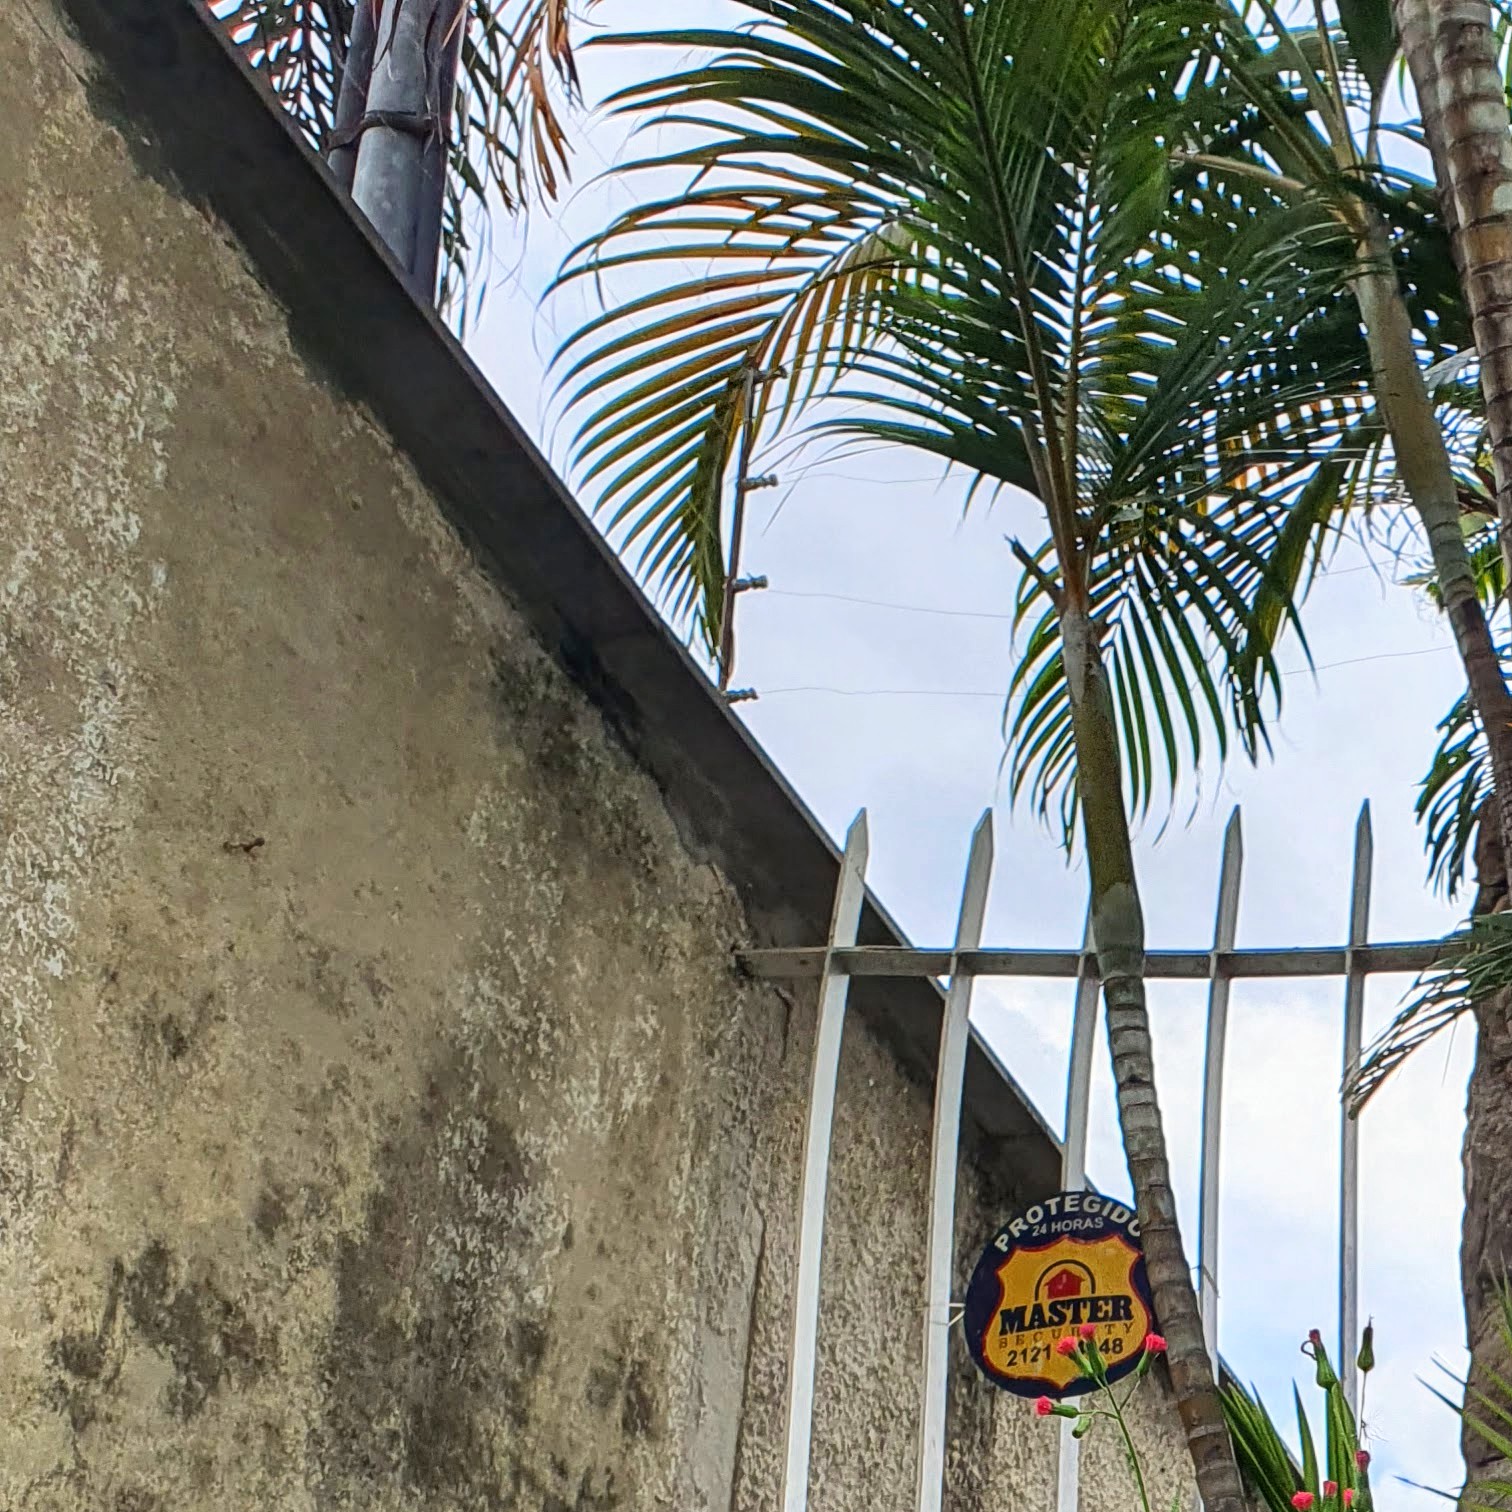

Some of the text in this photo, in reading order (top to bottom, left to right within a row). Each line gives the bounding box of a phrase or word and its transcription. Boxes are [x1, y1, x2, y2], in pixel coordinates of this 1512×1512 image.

[1032, 1216, 1104, 1238] 24 HORAS
[999, 1295, 1134, 1336] MASTER
[1007, 1344, 1052, 1367] 2121
